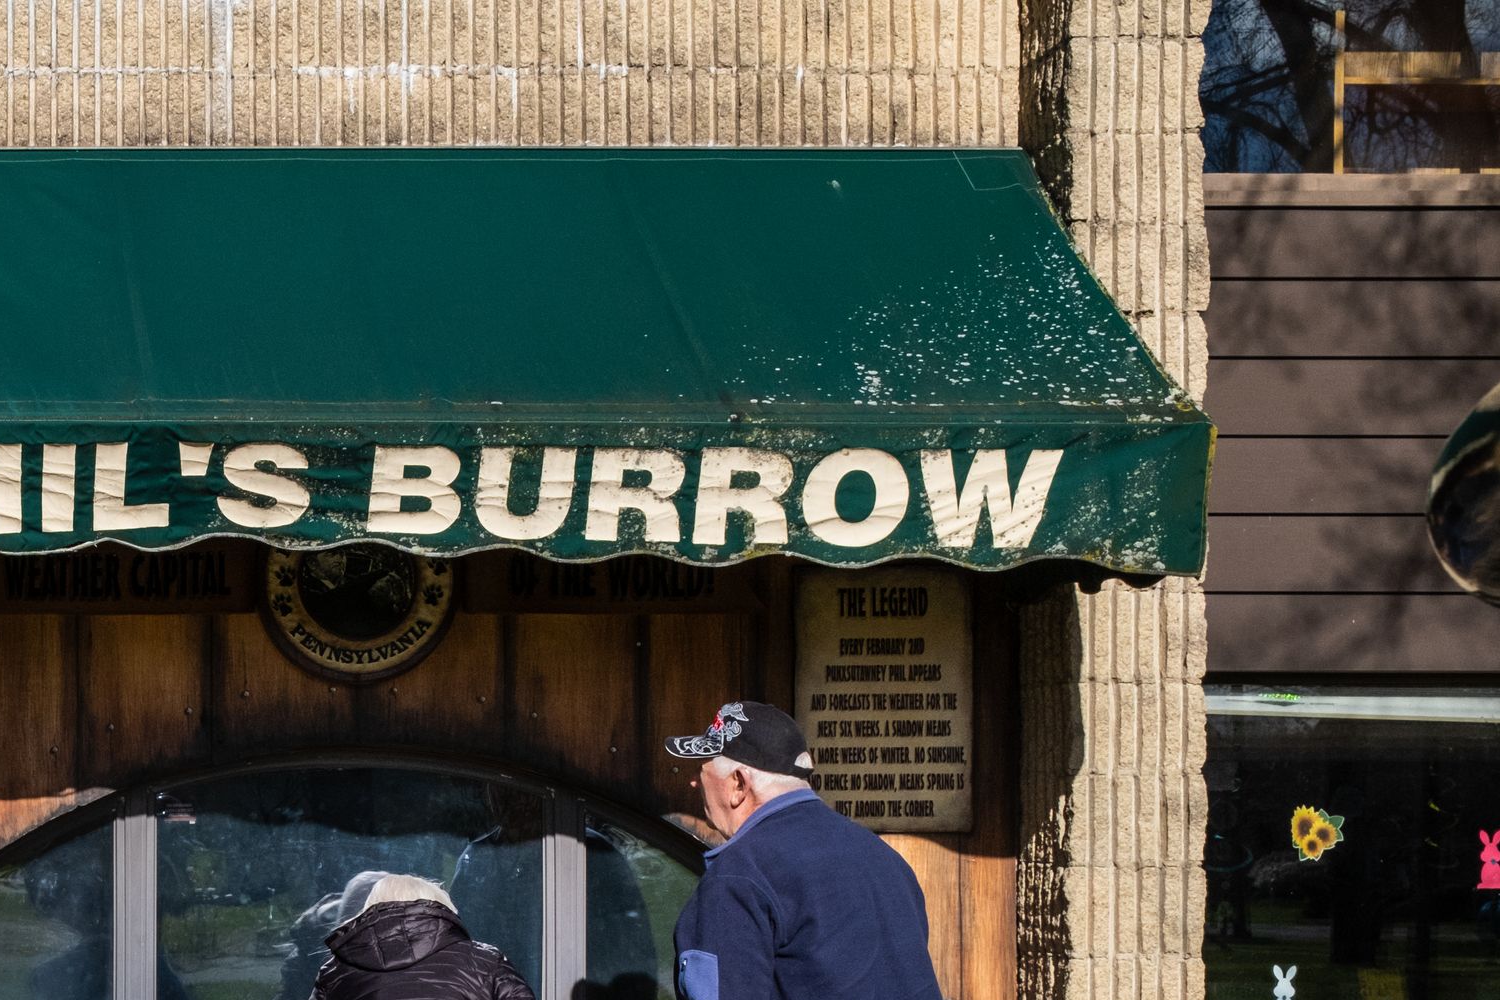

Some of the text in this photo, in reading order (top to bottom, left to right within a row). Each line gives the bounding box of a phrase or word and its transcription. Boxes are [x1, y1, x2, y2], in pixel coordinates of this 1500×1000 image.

[365, 441, 1066, 550] BURROW
[4, 552, 231, 599] WEATHER CAPITAL
[508, 555, 538, 596] OF
[838, 587, 928, 617] THE LEGEND
[289, 619, 432, 665] PENNSYLVANIA
[840, 639, 864, 656] EVERY
[867, 639, 906, 656] FEBRUARY
[888, 665, 906, 682] PHIL
[908, 665, 941, 682] APPEARS
[811, 694, 956, 711] AND FORECASTS THE WEATHER FOR THE
[817, 721, 837, 738] NEXT
[839, 721, 852, 738] SIX
[884, 721, 890, 738] A
[892, 721, 924, 738] SHADOW
[925, 721, 951, 738] MEANS
[818, 747, 838, 764] MORE
[840, 747, 866, 764] WEEKS
[868, 747, 878, 764] OF
[914, 747, 925, 764] NO
[824, 774, 848, 791] HENCE
[851, 774, 861, 791] NO
[899, 774, 924, 791] MEANS
[927, 774, 954, 791] SPRING
[957, 774, 964, 791] IS
[854, 801, 885, 818] AROUND
[887, 801, 902, 818] THE
[903, 801, 934, 818] CORNER
